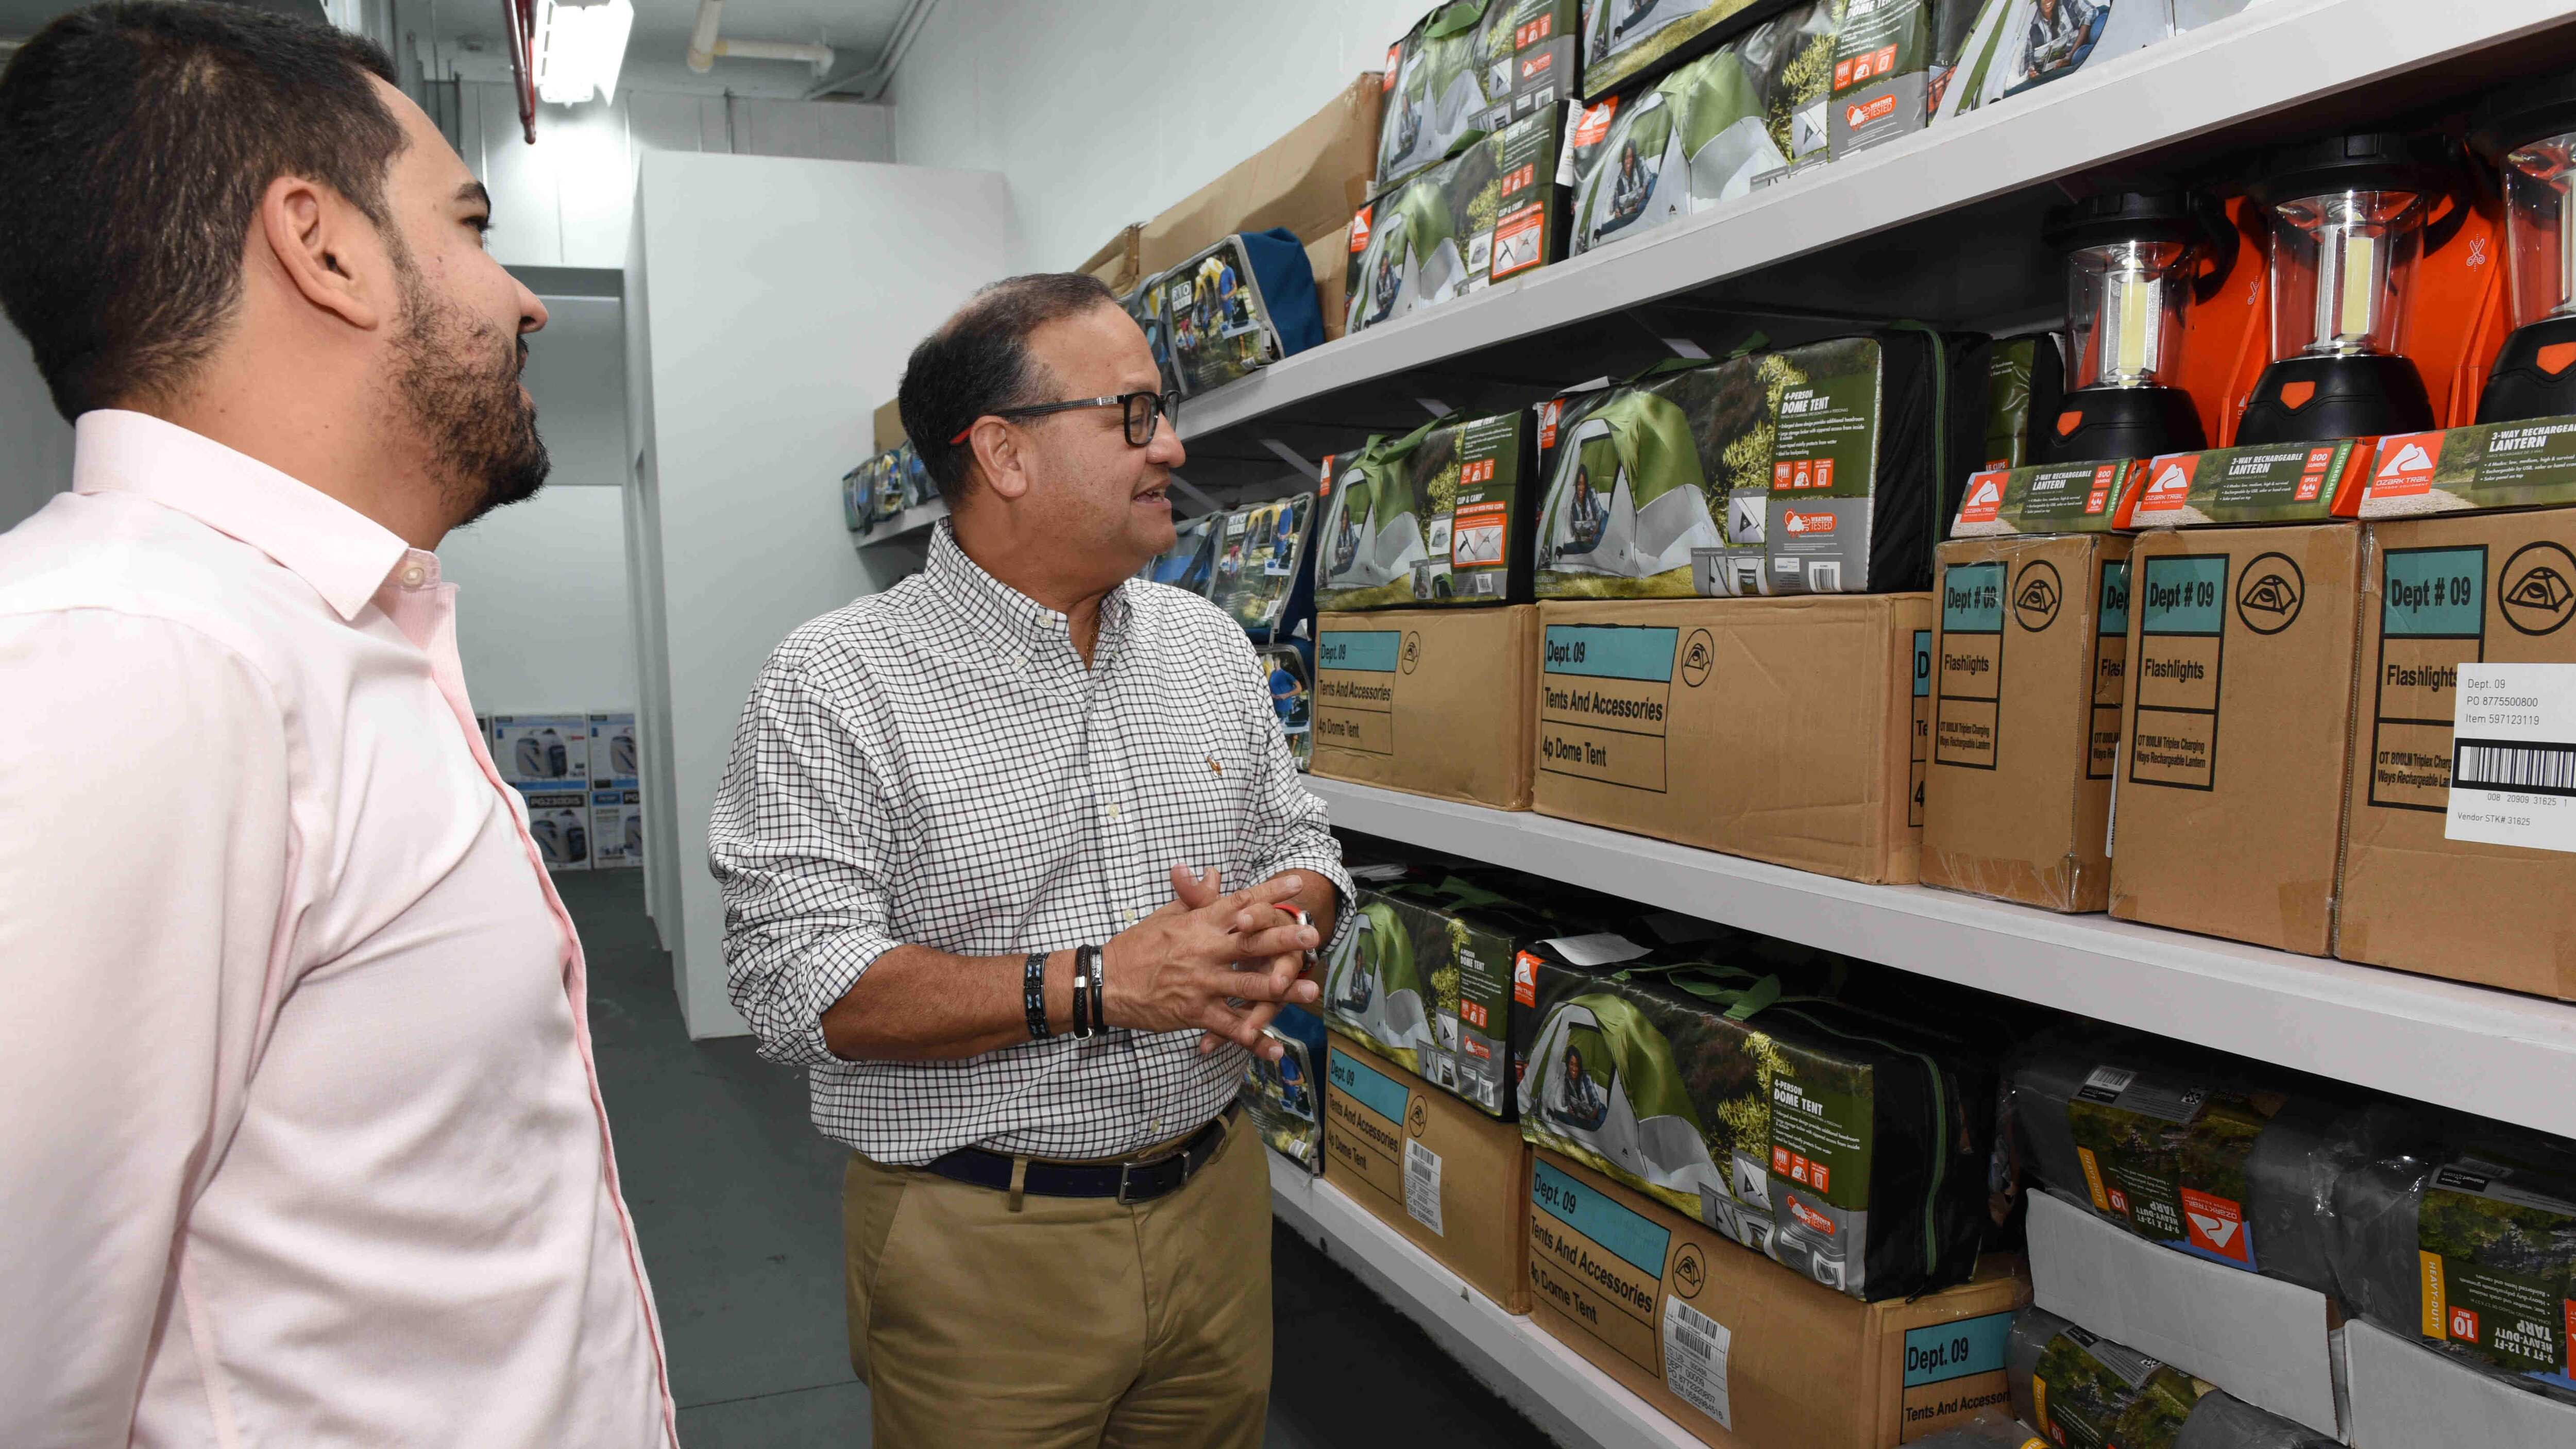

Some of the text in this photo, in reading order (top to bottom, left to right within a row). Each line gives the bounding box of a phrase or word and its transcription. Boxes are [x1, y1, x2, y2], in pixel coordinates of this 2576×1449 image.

[1871, 97, 1892, 109] WEATHER
[1871, 103, 1892, 117] TESTED
[1782, 399, 1808, 414] DOME
[1810, 396, 1830, 411] TENT
[1784, 390, 1814, 401] 4-PERSON
[2489, 435, 2547, 452] LANTERN
[2492, 430, 2520, 440] 3-WAY
[2253, 453, 2303, 463] RECHARGEABLE
[2311, 453, 2328, 462] 800
[2035, 470, 2092, 481] 3-WAY RECHARGEABLE
[2228, 463, 2271, 476] LANTERN
[2325, 448, 2348, 498] RECHARGEABLE
[2032, 479, 2066, 491] LANTERN
[2110, 465, 2127, 512] RECHARGEABLE
[1811, 521, 1833, 530] TESTED
[1948, 586, 1996, 614] Dept # 09
[2106, 586, 2129, 616] Dep
[2150, 582, 2213, 613] Dept # 09
[2392, 577, 2471, 609] Dept # 09
[1321, 644, 1346, 663] Dept. 09
[1547, 640, 1585, 666] Dept. 09
[1944, 653, 1989, 676] Flashlights
[2145, 659, 2204, 684] Flashlights
[2387, 664, 2458, 692] Flashlights
[2468, 679, 2505, 689] Dept. 09
[1319, 679, 1391, 701] Tents And Accessories
[1545, 687, 1663, 721] Tents And Accessories
[2467, 696, 2538, 707] PO 8775500800
[1319, 718, 1359, 738] 4p Dome Tent
[2466, 714, 2539, 726] Item 597123119
[1543, 736, 1606, 767] 4p Dome Tent
[2138, 734, 2205, 754] OT 800LM Triplex Charging
[2137, 750, 2206, 768] Ways Rechargeable Lantern
[2379, 752, 2452, 772] OT 800LM Triplex Charg
[2378, 769, 2396, 786] Ways
[2397, 770, 2437, 788] Rechargeable
[2488, 793, 2500, 802] 008
[2507, 795, 2529, 804] 20909
[2534, 796, 2556, 806] 31625
[2458, 813, 2530, 826] Vendor STK# 31625
[1461, 956, 1485, 971] DOME TENT
[1330, 1058, 1354, 1087] Dept. 09
[1774, 1079, 1802, 1096] 4-PERSON
[1774, 1088, 1799, 1107] DOME
[1802, 1098, 1823, 1116] TENT
[1329, 1093, 1398, 1153] Tents And Accessories
[1337, 1135, 1351, 1158] Dome
[1352, 1147, 1367, 1171] Tent
[2084, 1154, 2103, 1203] HEAVY-DUTY
[1535, 1173, 1576, 1214] Dept. 09
[2112, 1195, 2125, 1211] 10
[2136, 1206, 2178, 1226] HEAVY-DUTY
[2149, 1201, 2177, 1218] TARP
[1811, 1219, 1831, 1233] TESTED
[2137, 1215, 2155, 1226] 12-FT
[2164, 1223, 2179, 1234] 9-FT
[1531, 1216, 1652, 1313] Tents And Accessories
[1531, 1260, 1597, 1325] 4p Dome Tent
[2469, 1288, 2488, 1298] resistant
[2504, 1281, 2517, 1290] hems
[2518, 1284, 2545, 1297] Reinforced
[2429, 1261, 2439, 1330] HEAVY-DUTY
[2517, 1293, 2546, 1306] Heavy-duty
[2513, 1301, 2534, 1311] weather
[2454, 1317, 2475, 1339] 10
[2517, 1320, 2552, 1341] TARP
[2495, 1327, 2552, 1354] HEAVY-DUTY
[1908, 1337, 1969, 1374] Dept. 09
[2494, 1338, 2553, 1364] 9-FT X 12-FT
[1906, 1403, 1934, 1422] Tents
[1937, 1399, 1957, 1417] And
